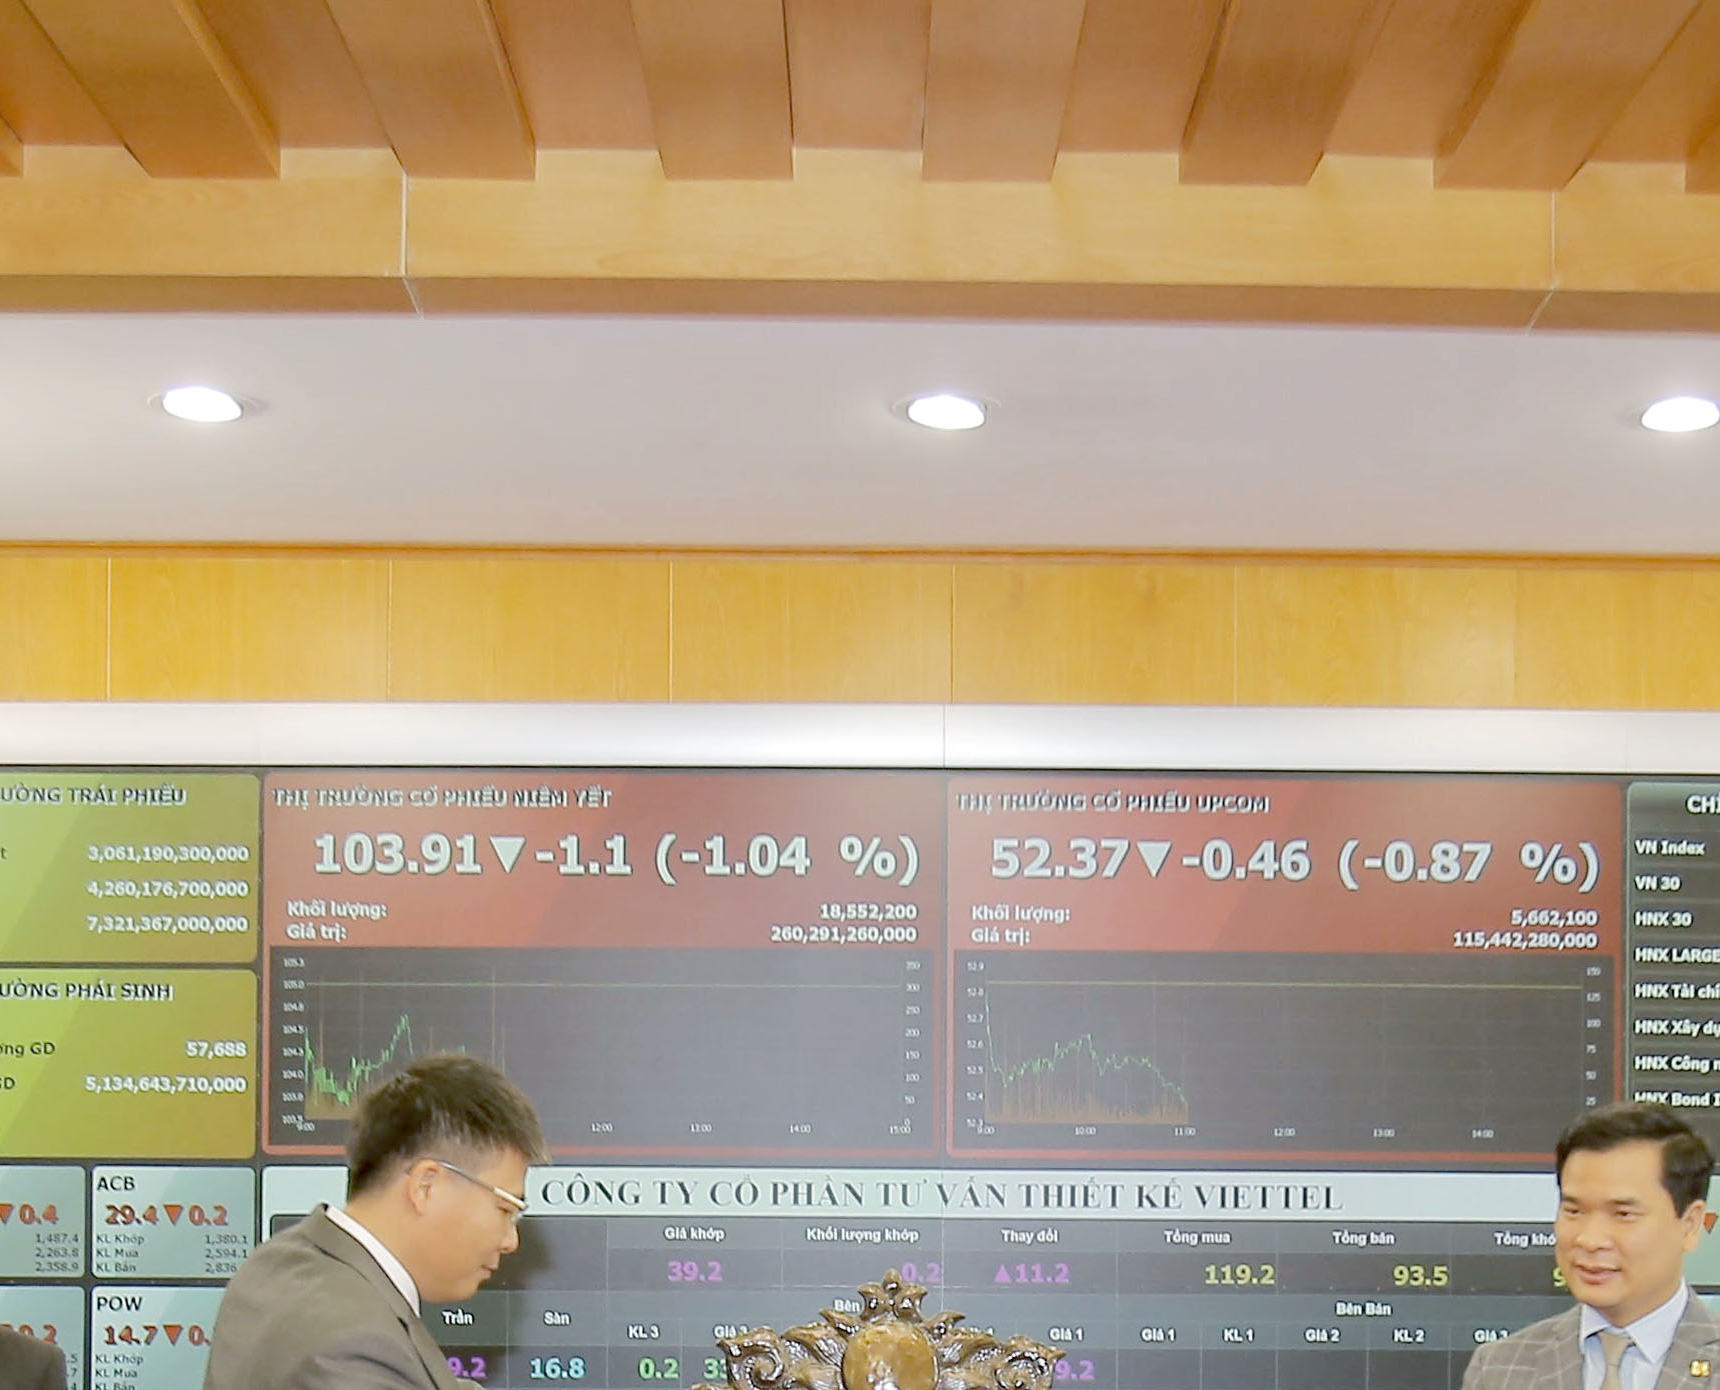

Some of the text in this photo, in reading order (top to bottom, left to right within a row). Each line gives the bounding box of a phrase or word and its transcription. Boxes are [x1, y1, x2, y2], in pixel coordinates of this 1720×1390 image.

[68, 785, 118, 804] TRÁI
[1635, 840, 1705, 855] VN Index
[314, 831, 920, 887] 103.91 -1.1 (-1.04 %)
[990, 837, 1600, 893] 52.37 -0.46 (-0.87 %)
[1635, 876, 1680, 890] VN 30
[1014, 905, 1071, 924] lượng:
[1511, 908, 1599, 927] 5,662,100
[1635, 912, 1692, 927] HNX 30
[971, 928, 999, 944] Giá
[1635, 948, 1669, 963] HNX
[120, 983, 174, 1002] SINH
[1635, 984, 1669, 999] HNX
[1635, 1020, 1669, 1034] HNX
[30, 1041, 56, 1055] GD
[1635, 1056, 1669, 1071] HNX
[1671, 1057, 1710, 1074] Công
[1672, 1093, 1710, 1107] Bond
[96, 1175, 135, 1191] ACB
[540, 1173, 1344, 1211] CÔNG TY CỔ PHẦN TƯ VẤN THIẾT KẾ VIETTEL
[105, 1204, 228, 1226] 29.4 0.2
[1001, 1229, 1034, 1245] Thay
[1164, 1229, 1231, 1245] Tổng mua
[667, 1261, 723, 1282] 39.2
[1015, 1263, 1070, 1283] 11.2
[1204, 1264, 1276, 1285] 119.2
[1393, 1264, 1449, 1287] 93.5
[96, 1295, 143, 1311] POW
[529, 1357, 587, 1379] 16.8
[638, 1357, 680, 1379] 0.2
